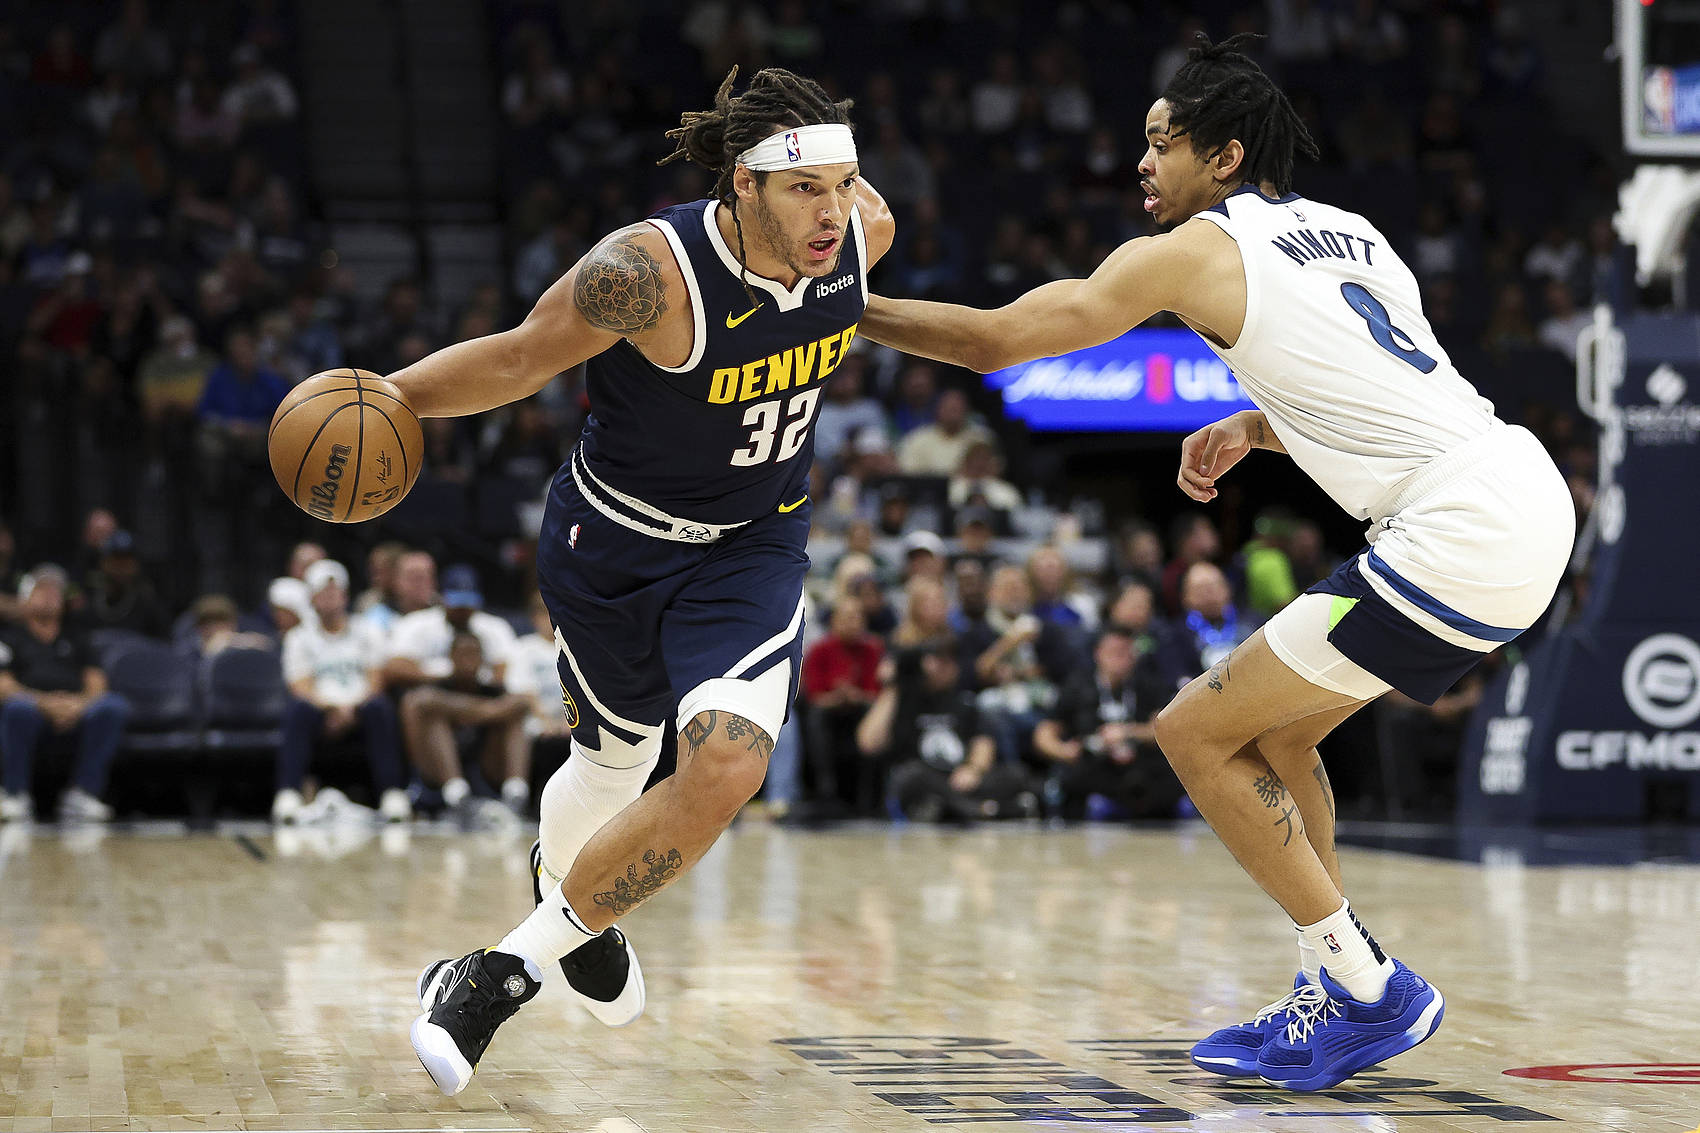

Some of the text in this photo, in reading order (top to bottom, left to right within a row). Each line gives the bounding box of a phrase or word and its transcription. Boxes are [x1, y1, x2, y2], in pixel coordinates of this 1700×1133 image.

[816, 274, 855, 299] ibotta
[1271, 229, 1375, 267] MINOTT
[707, 322, 858, 405] DENVER
[1340, 282, 1438, 374] 8
[1174, 357, 1250, 402] UL
[729, 387, 822, 467] 32
[307, 444, 352, 520] Wilson
[773, 1035, 1198, 1124] CENTER
